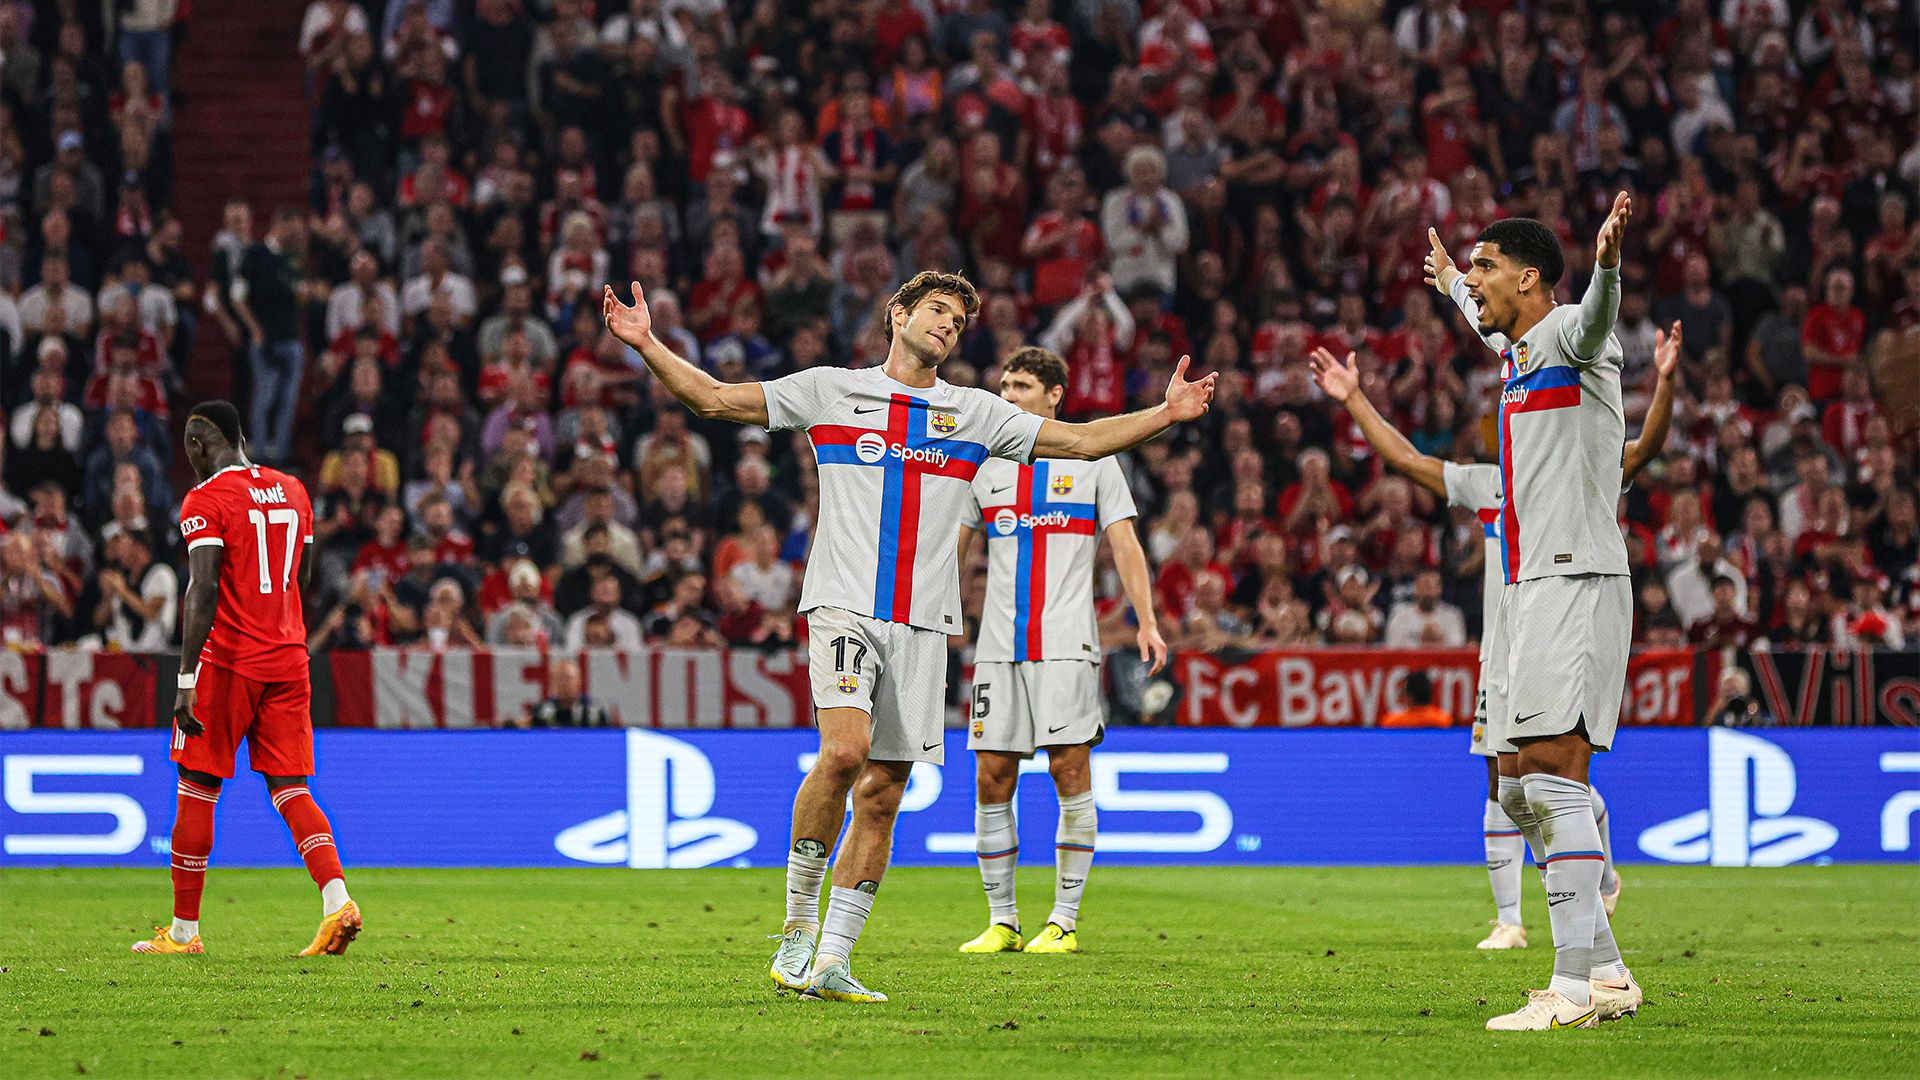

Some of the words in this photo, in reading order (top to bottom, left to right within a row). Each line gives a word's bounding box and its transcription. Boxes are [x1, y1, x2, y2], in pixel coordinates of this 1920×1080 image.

[890, 442, 949, 468] Spotify
[248, 482, 287, 504] MANÉ
[1020, 510, 1071, 530] Spotify
[248, 508, 299, 594] 17
[830, 635, 868, 675] 17
[971, 682, 992, 720] 15
